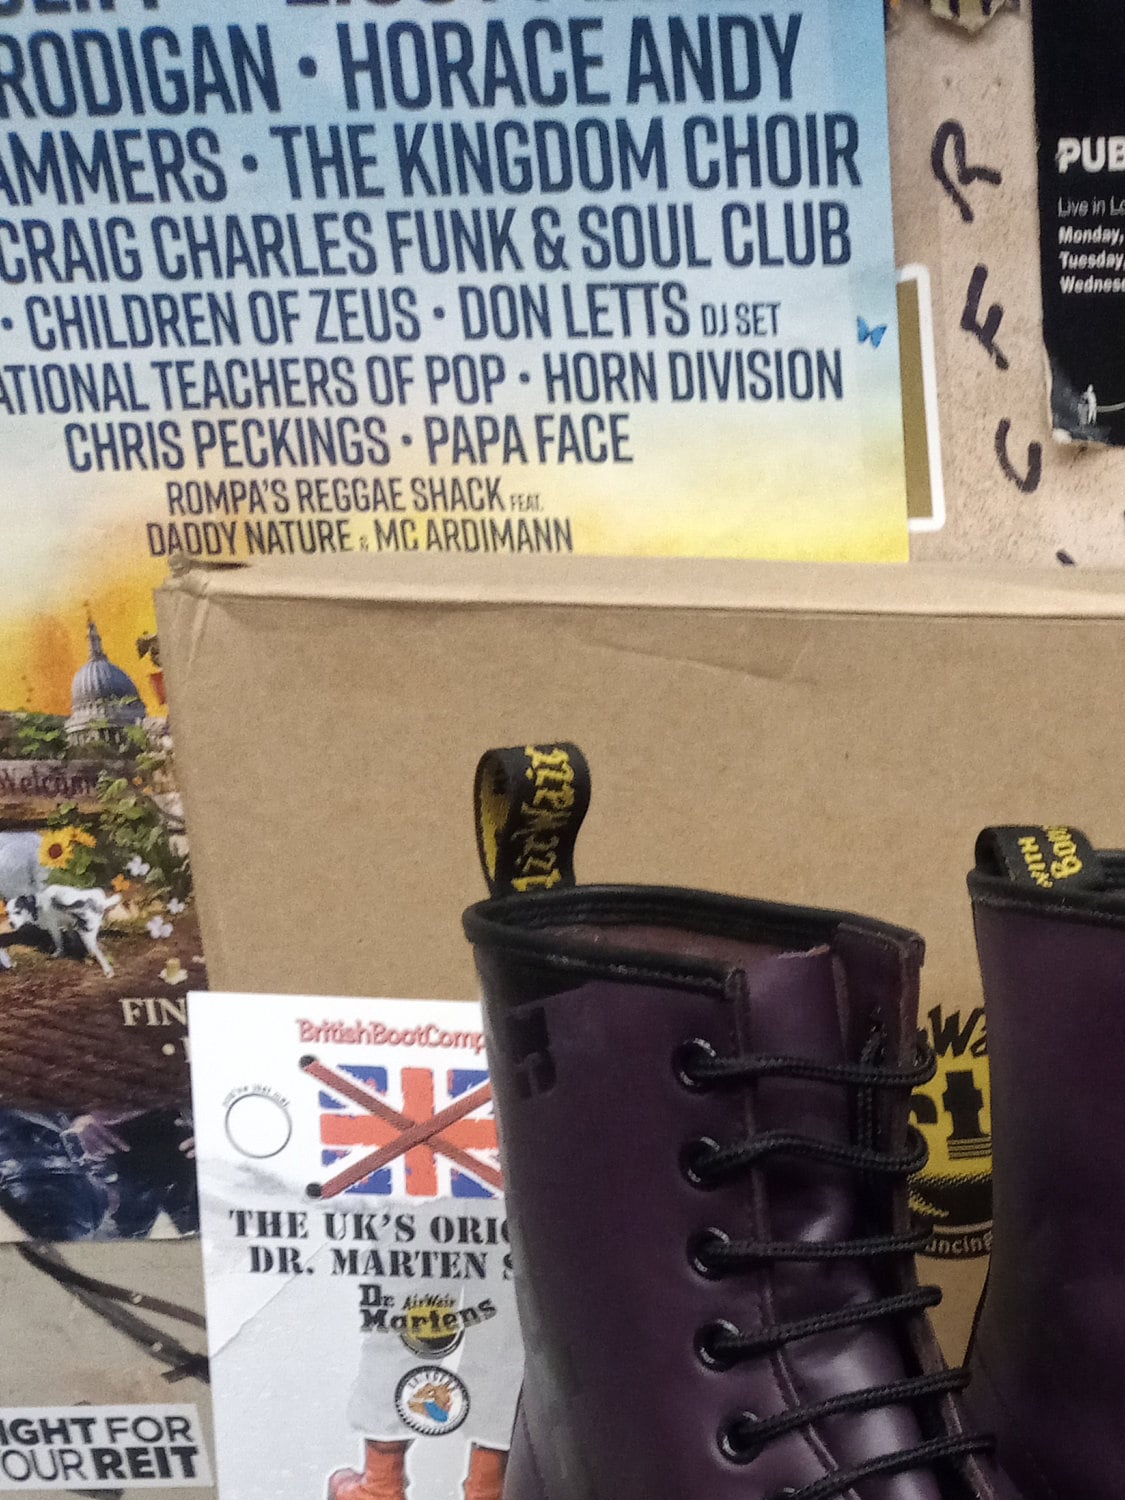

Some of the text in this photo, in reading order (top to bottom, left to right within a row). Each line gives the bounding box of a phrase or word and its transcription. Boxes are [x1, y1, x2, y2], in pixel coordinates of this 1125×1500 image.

[0, 13, 802, 118] RODIGAN HORACE ANDY
[269, 124, 385, 200] THE
[393, 116, 668, 198] KINGDOM
[683, 111, 862, 191] CHOIR
[1058, 196, 1088, 217] Live
[1092, 196, 1106, 216] in
[0, 201, 851, 284] CRAIG CHARLES FUNK & SOUL CLUB
[1058, 225, 1125, 245] Monday,
[25, 281, 781, 351] CHILDREN OF ZEUS DON LETTS DJ SET
[151, 357, 358, 411] TEACHERS
[366, 356, 414, 406] OF
[425, 354, 505, 405] POP
[543, 350, 658, 404] HORN
[669, 348, 843, 402] DIVISION
[64, 413, 633, 472] CHRIS PECKINGS PAPA FACE
[166, 477, 544, 516] ROMPA'S REGGAE SHACK FEAT.
[147, 521, 237, 557] DADDY
[244, 520, 351, 555] NATURE
[374, 520, 418, 552] MC
[427, 517, 573, 552] ARDIMANN
[118, 997, 187, 1026] FIN
[230, 1209, 308, 1239] THE
[322, 1212, 416, 1243] UK'S
[249, 1245, 315, 1275] DR.
[330, 1249, 488, 1280] MARTEN
[359, 1298, 498, 1333] Martens
[0, 1415, 193, 1446] IGHT FOR
[1, 1446, 198, 1481] OUR REIT
